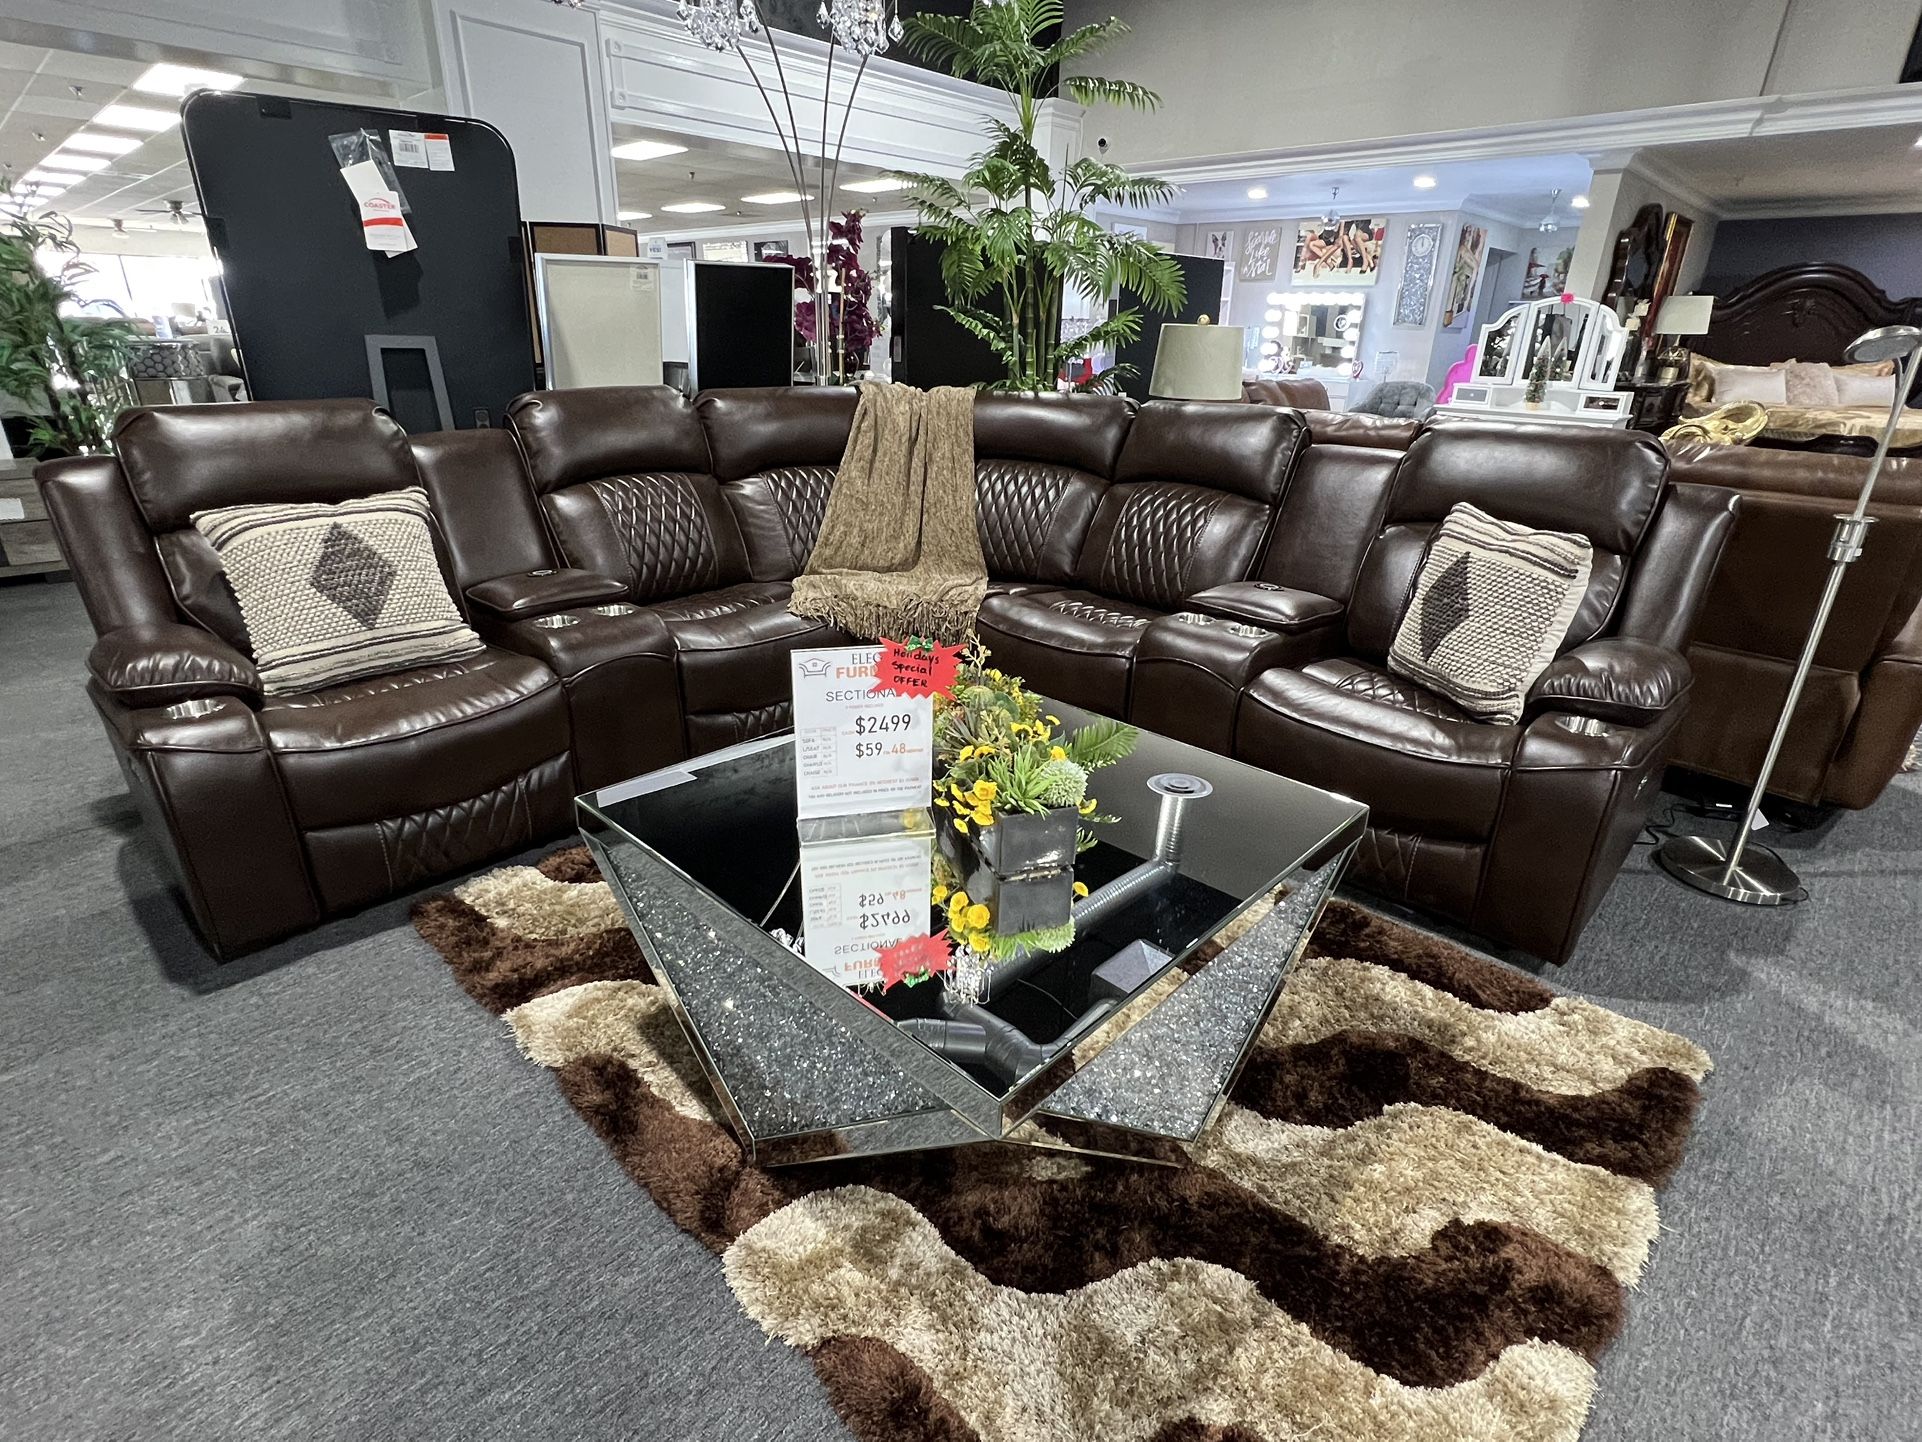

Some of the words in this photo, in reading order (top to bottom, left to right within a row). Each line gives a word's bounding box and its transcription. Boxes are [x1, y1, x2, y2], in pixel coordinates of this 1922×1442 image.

[364, 202, 395, 210] COASTER
[826, 688, 898, 702] SECTIONA
[855, 714, 911, 736] $2499
[855, 741, 883, 759] $59
[891, 743, 906, 755] 48
